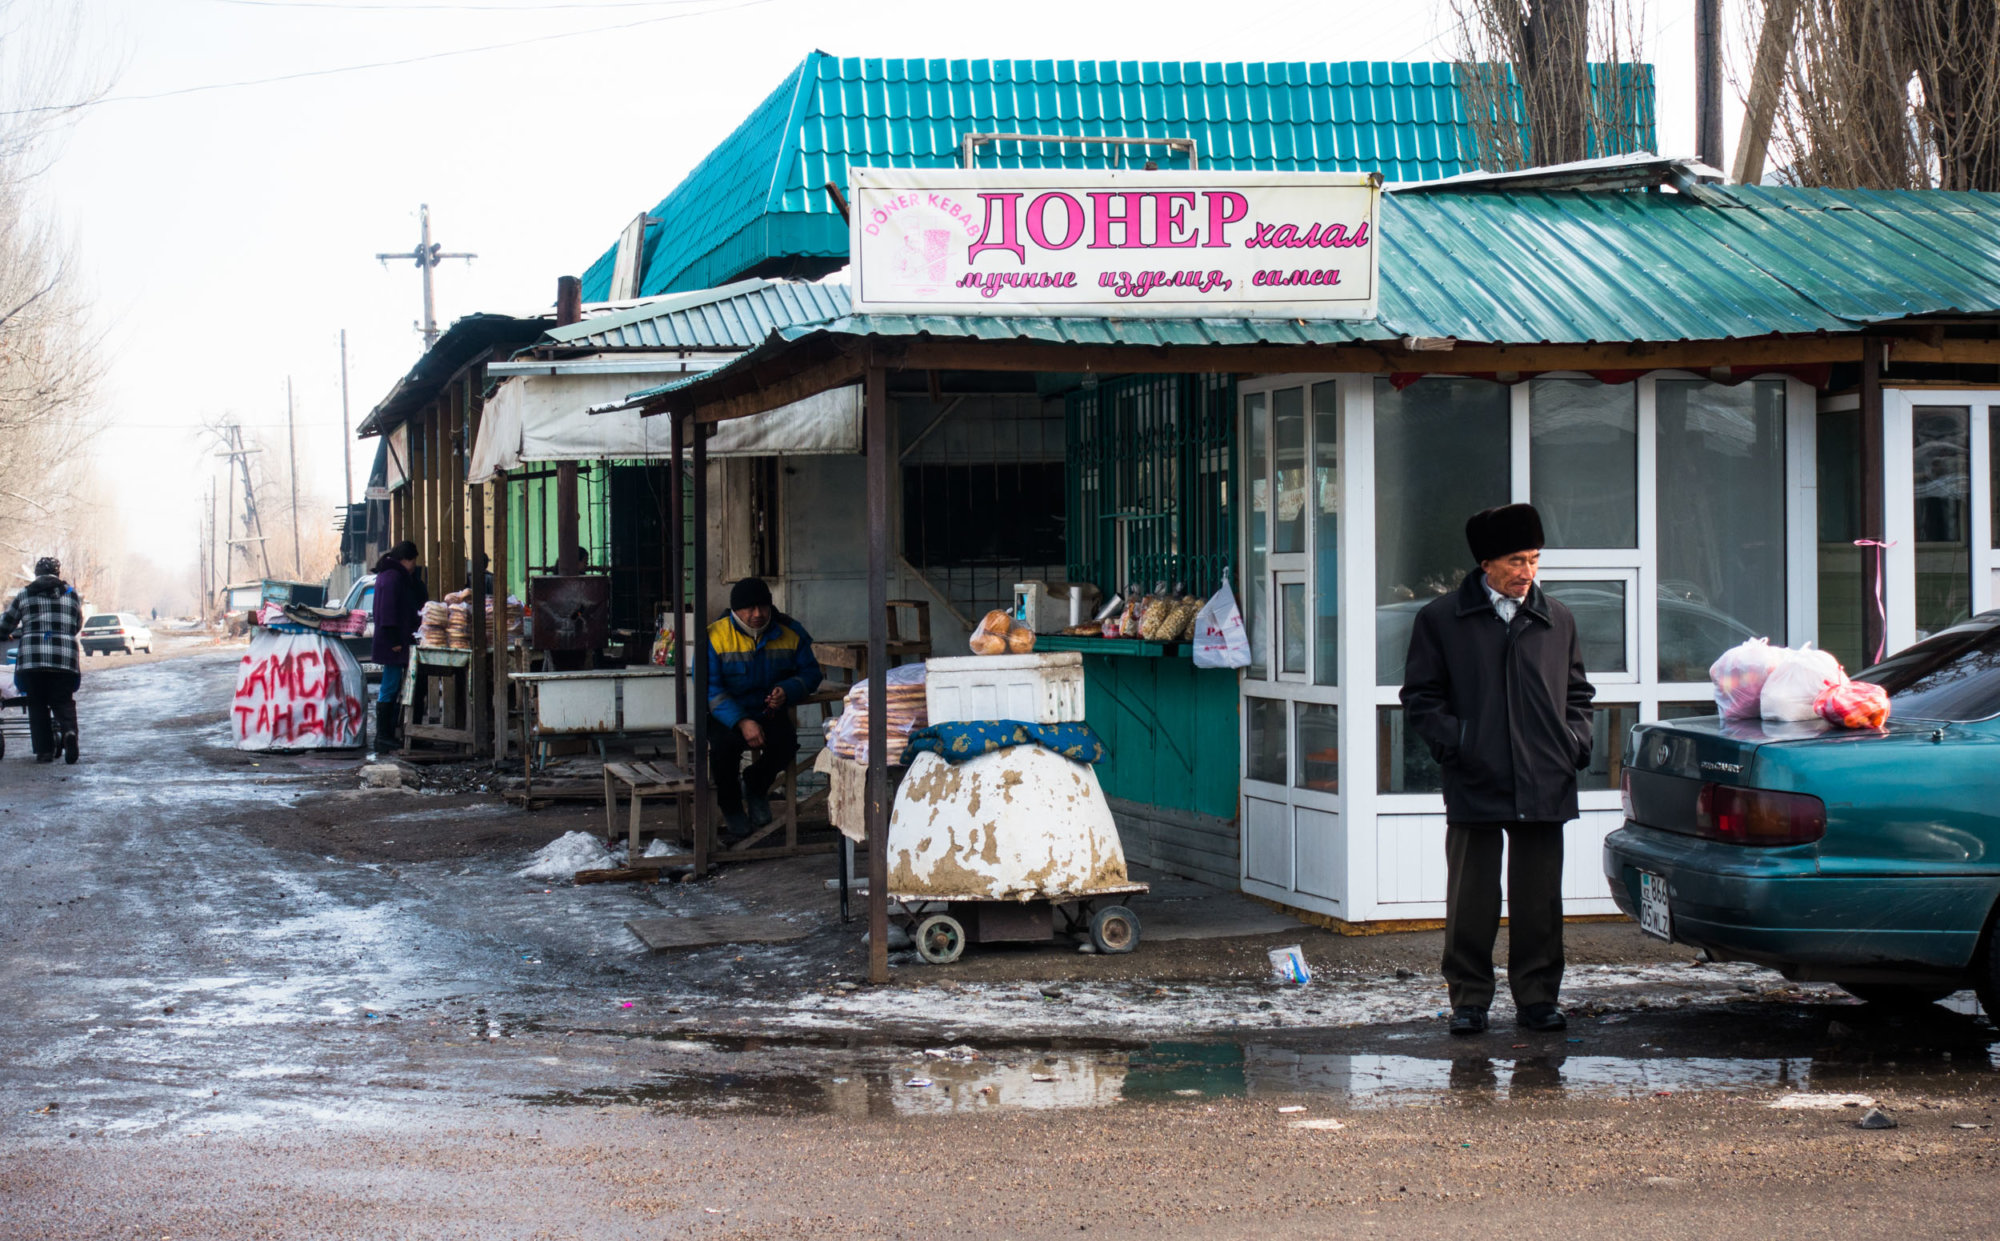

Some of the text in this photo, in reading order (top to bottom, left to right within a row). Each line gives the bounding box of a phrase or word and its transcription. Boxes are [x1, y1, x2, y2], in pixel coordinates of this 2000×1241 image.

[865, 193, 981, 237] DÖNER KEBAB
[967, 191, 1369, 265] ДОНЕР халал
[956, 268, 1342, 298] мучные изделия, самса
[235, 647, 342, 702] САМСА
[1651, 876, 1668, 906] 866
[1642, 902, 1652, 927] 05
